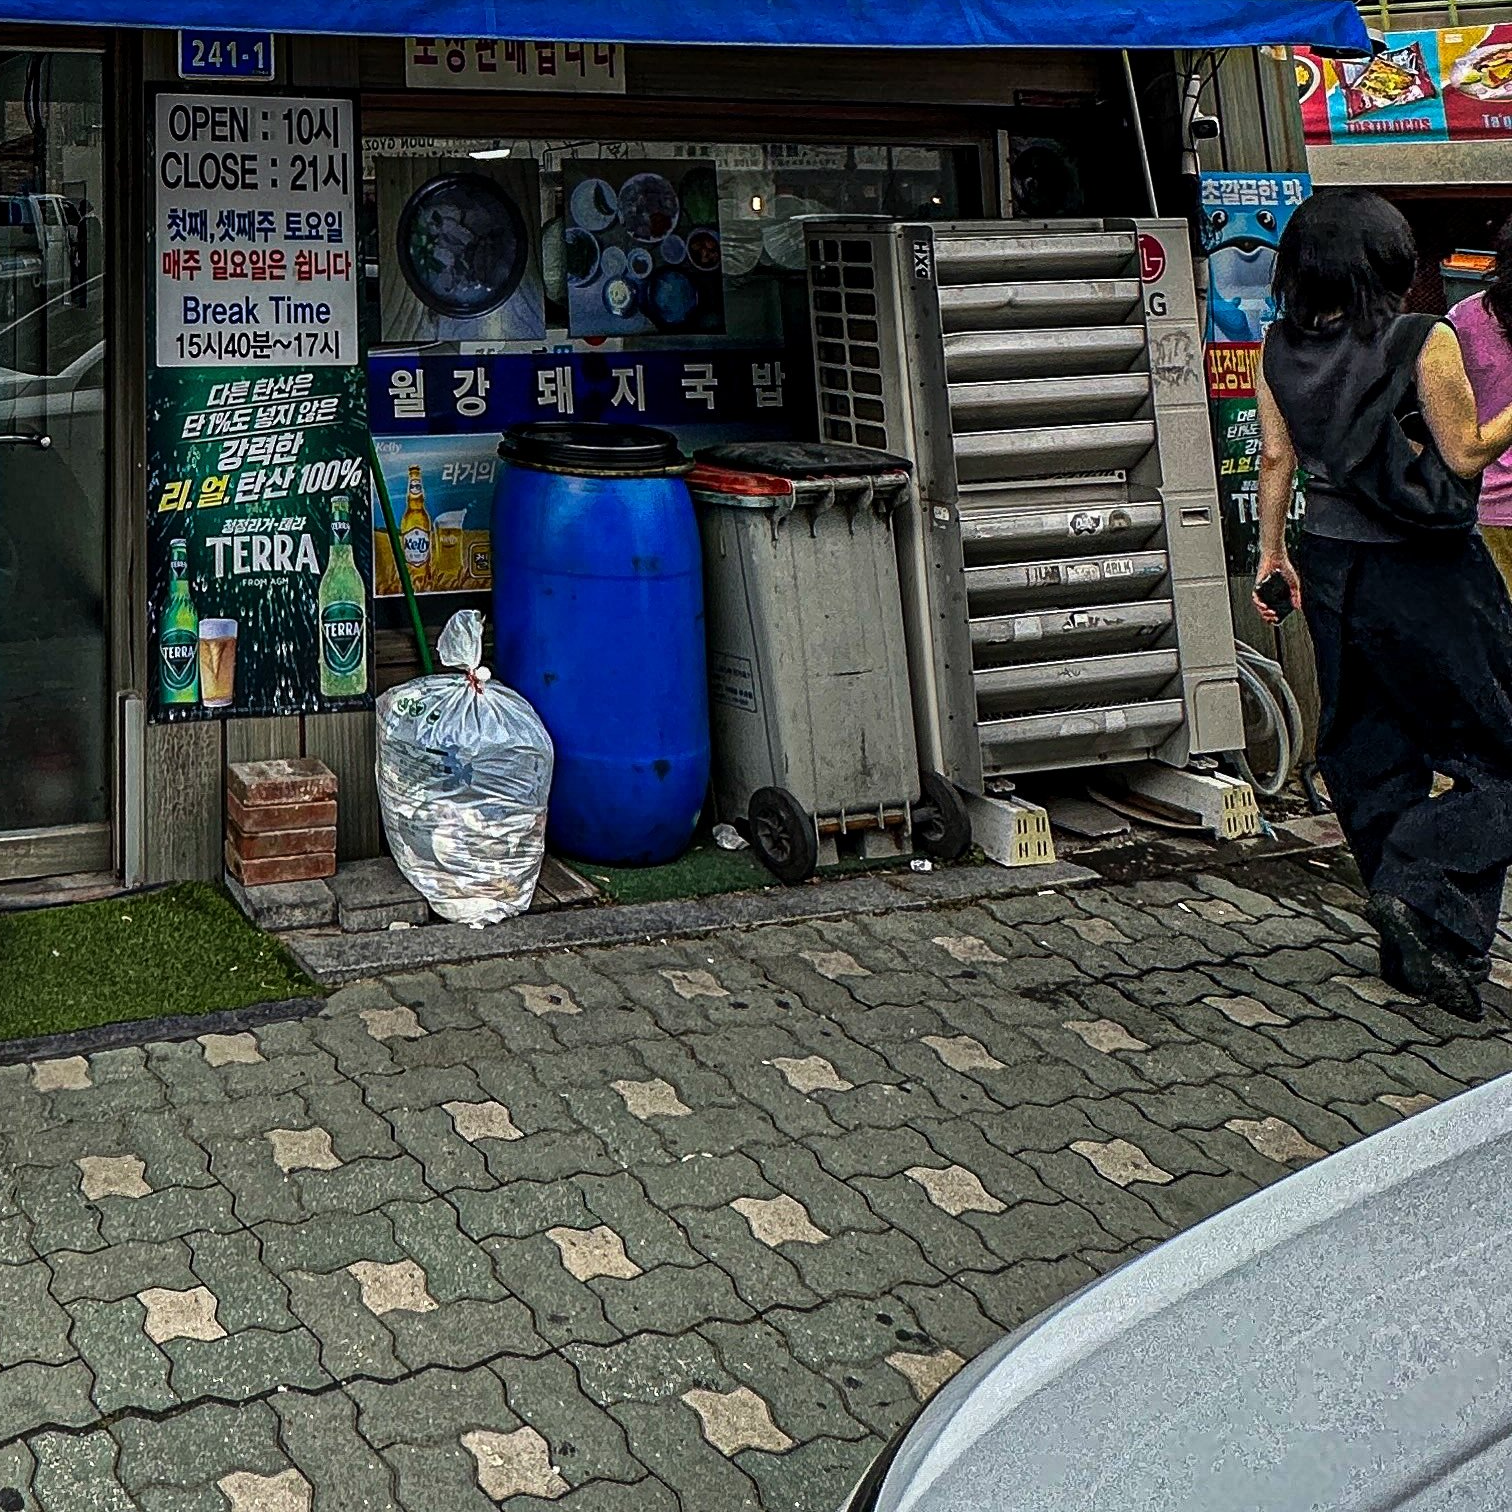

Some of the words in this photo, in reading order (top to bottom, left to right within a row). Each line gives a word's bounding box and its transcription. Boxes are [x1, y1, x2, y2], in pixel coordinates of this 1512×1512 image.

[192, 39, 264, 68] 241-1
[169, 104, 248, 143] OPEN
[282, 106, 339, 148] 10시
[161, 152, 258, 190] CLOSE
[290, 153, 348, 194] 21시
[284, 211, 343, 243] 토요일
[163, 249, 201, 281] 매주
[210, 249, 286, 281] 일요일은
[295, 250, 351, 281] 쉽니다
[183, 296, 259, 324] Break
[269, 296, 330, 324] Time
[207, 381, 250, 406] 다른
[252, 373, 314, 402] 탄산은
[181, 412, 205, 438] 단
[296, 398, 339, 425] 않은
[217, 431, 304, 471] 강력한
[234, 467, 296, 503] 탄산
[298, 457, 362, 494] 100%
[205, 534, 320, 578] TERRA
[324, 623, 361, 636] TERRA
[163, 646, 194, 658] TERRA
